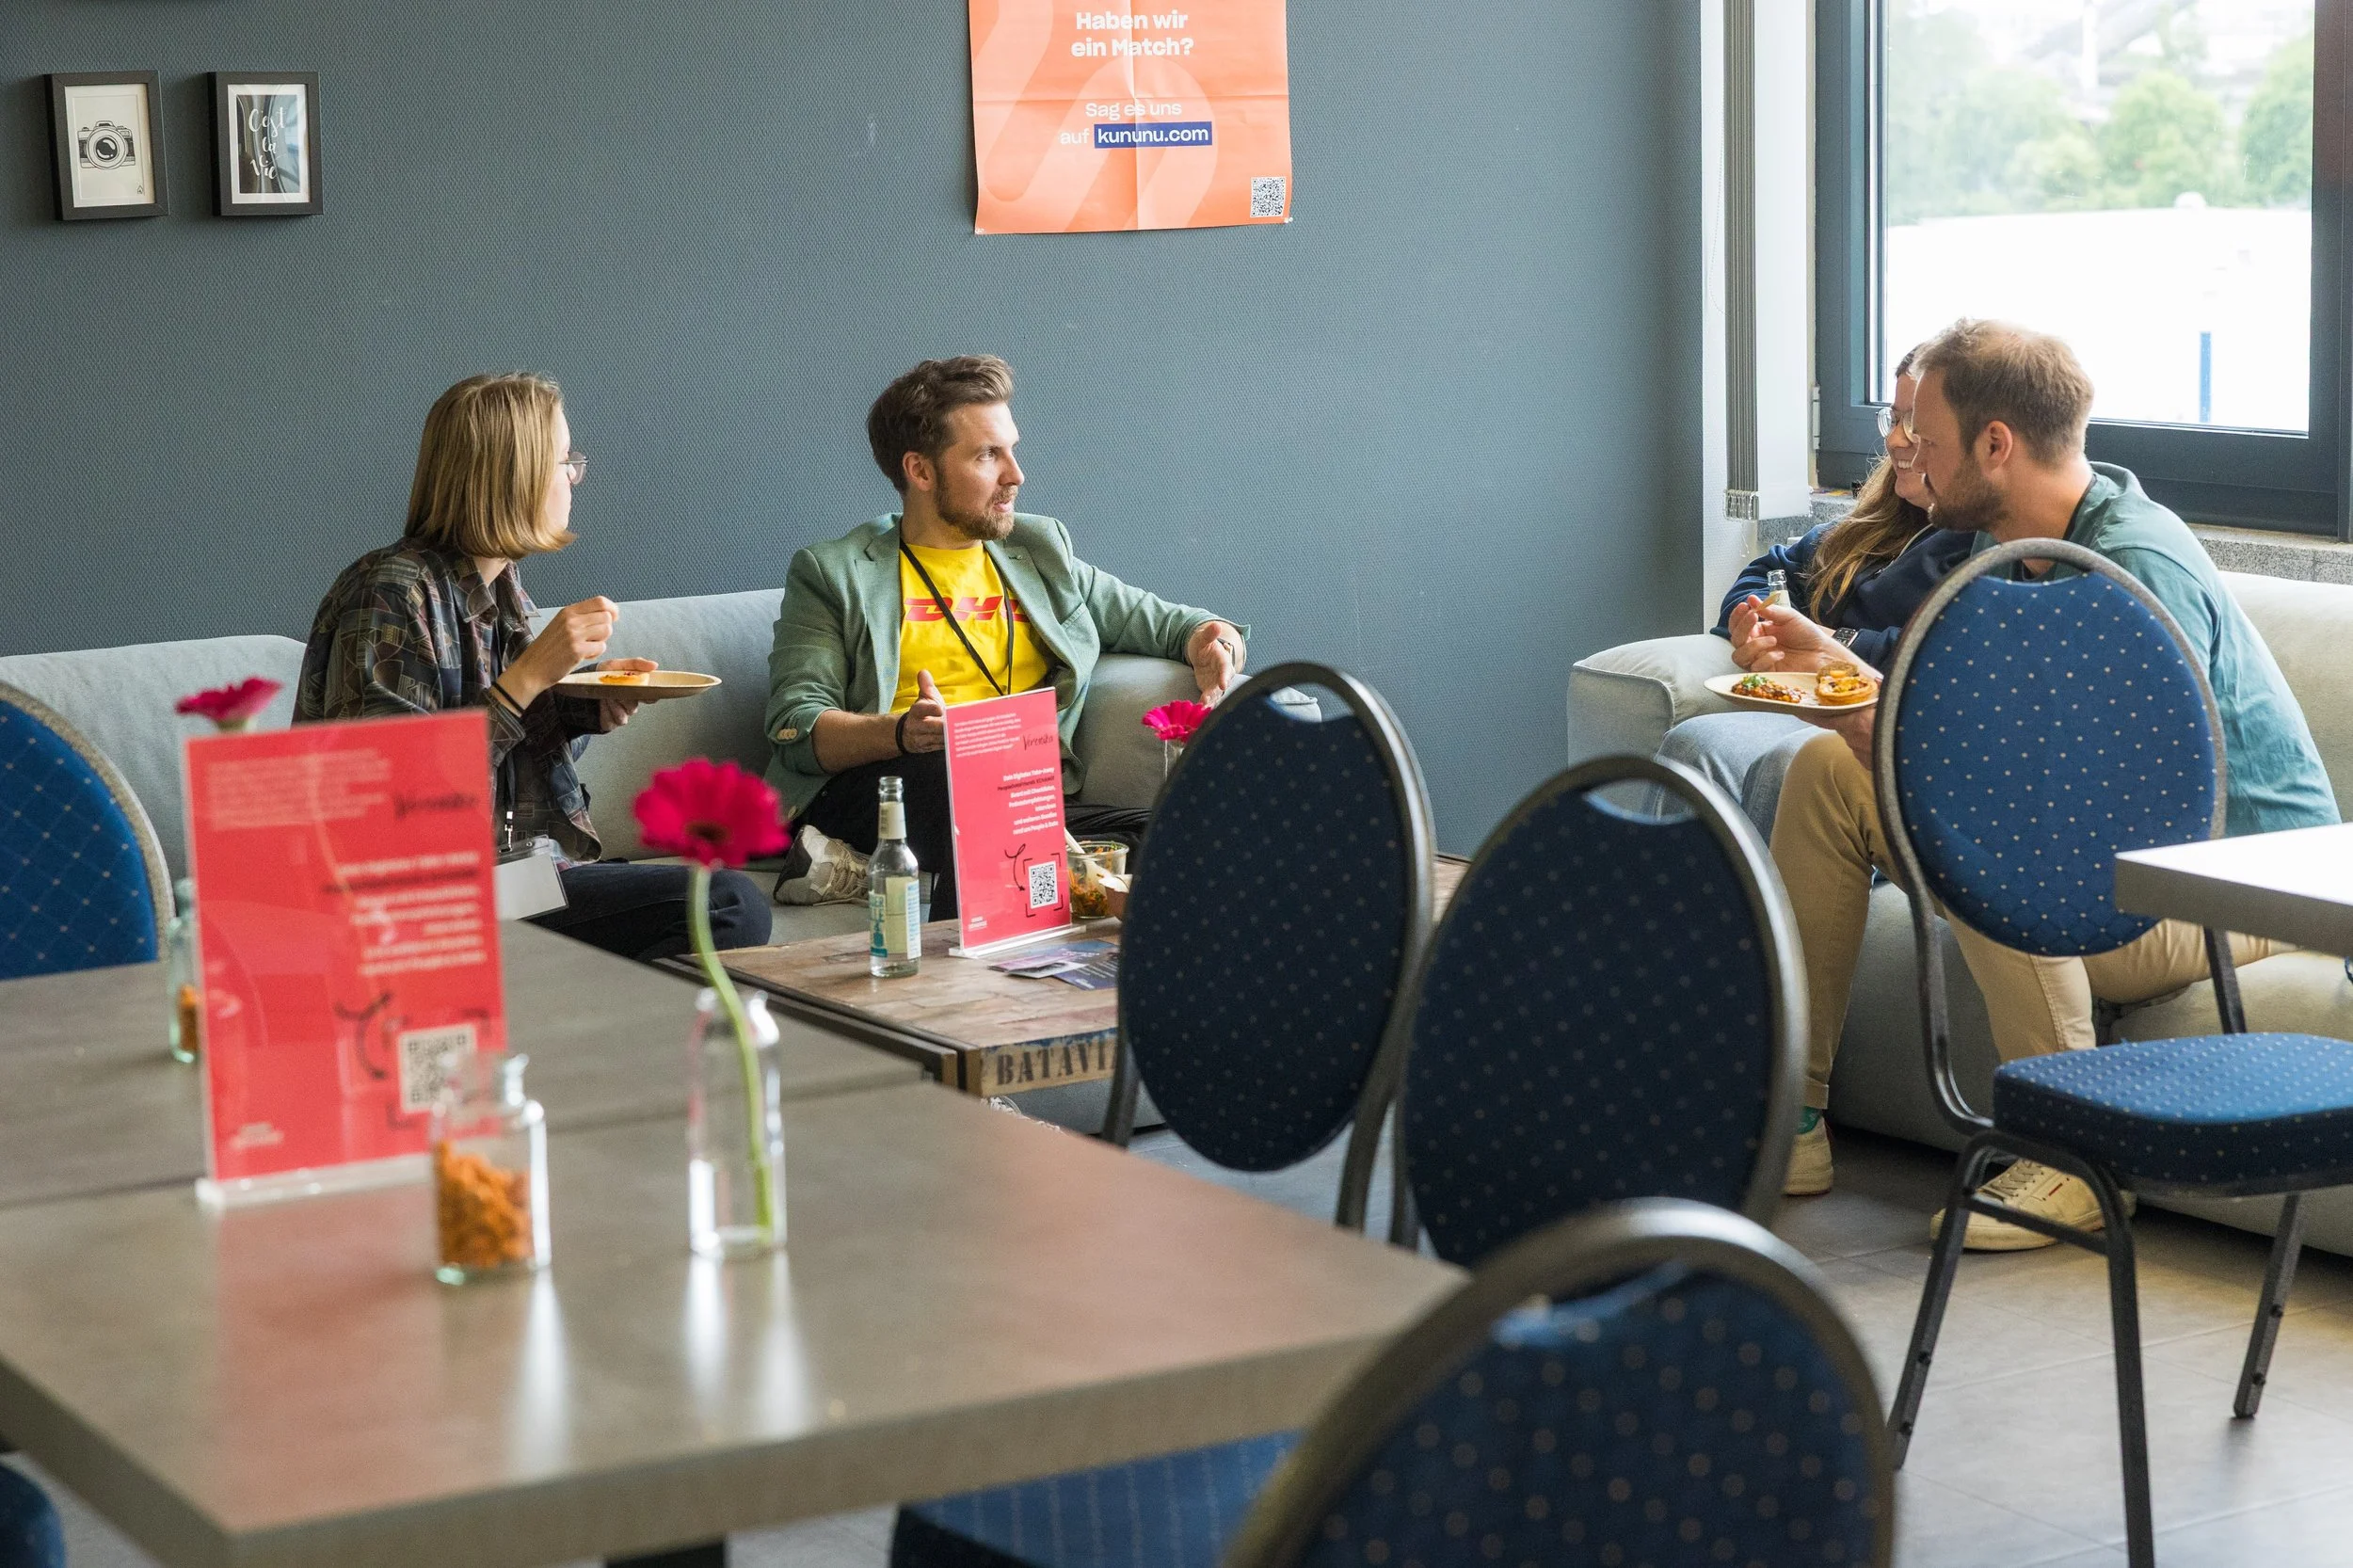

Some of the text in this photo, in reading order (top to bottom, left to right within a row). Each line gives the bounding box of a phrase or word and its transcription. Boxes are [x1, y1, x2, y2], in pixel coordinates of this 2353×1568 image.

[1076, 9, 1188, 30] Haben wir
[1071, 38, 1194, 57] ein Match?
[1085, 102, 1182, 121] Sag es uns
[1060, 126, 1209, 145] auf kununu.com
[997, 1037, 1117, 1085] BATAVI
